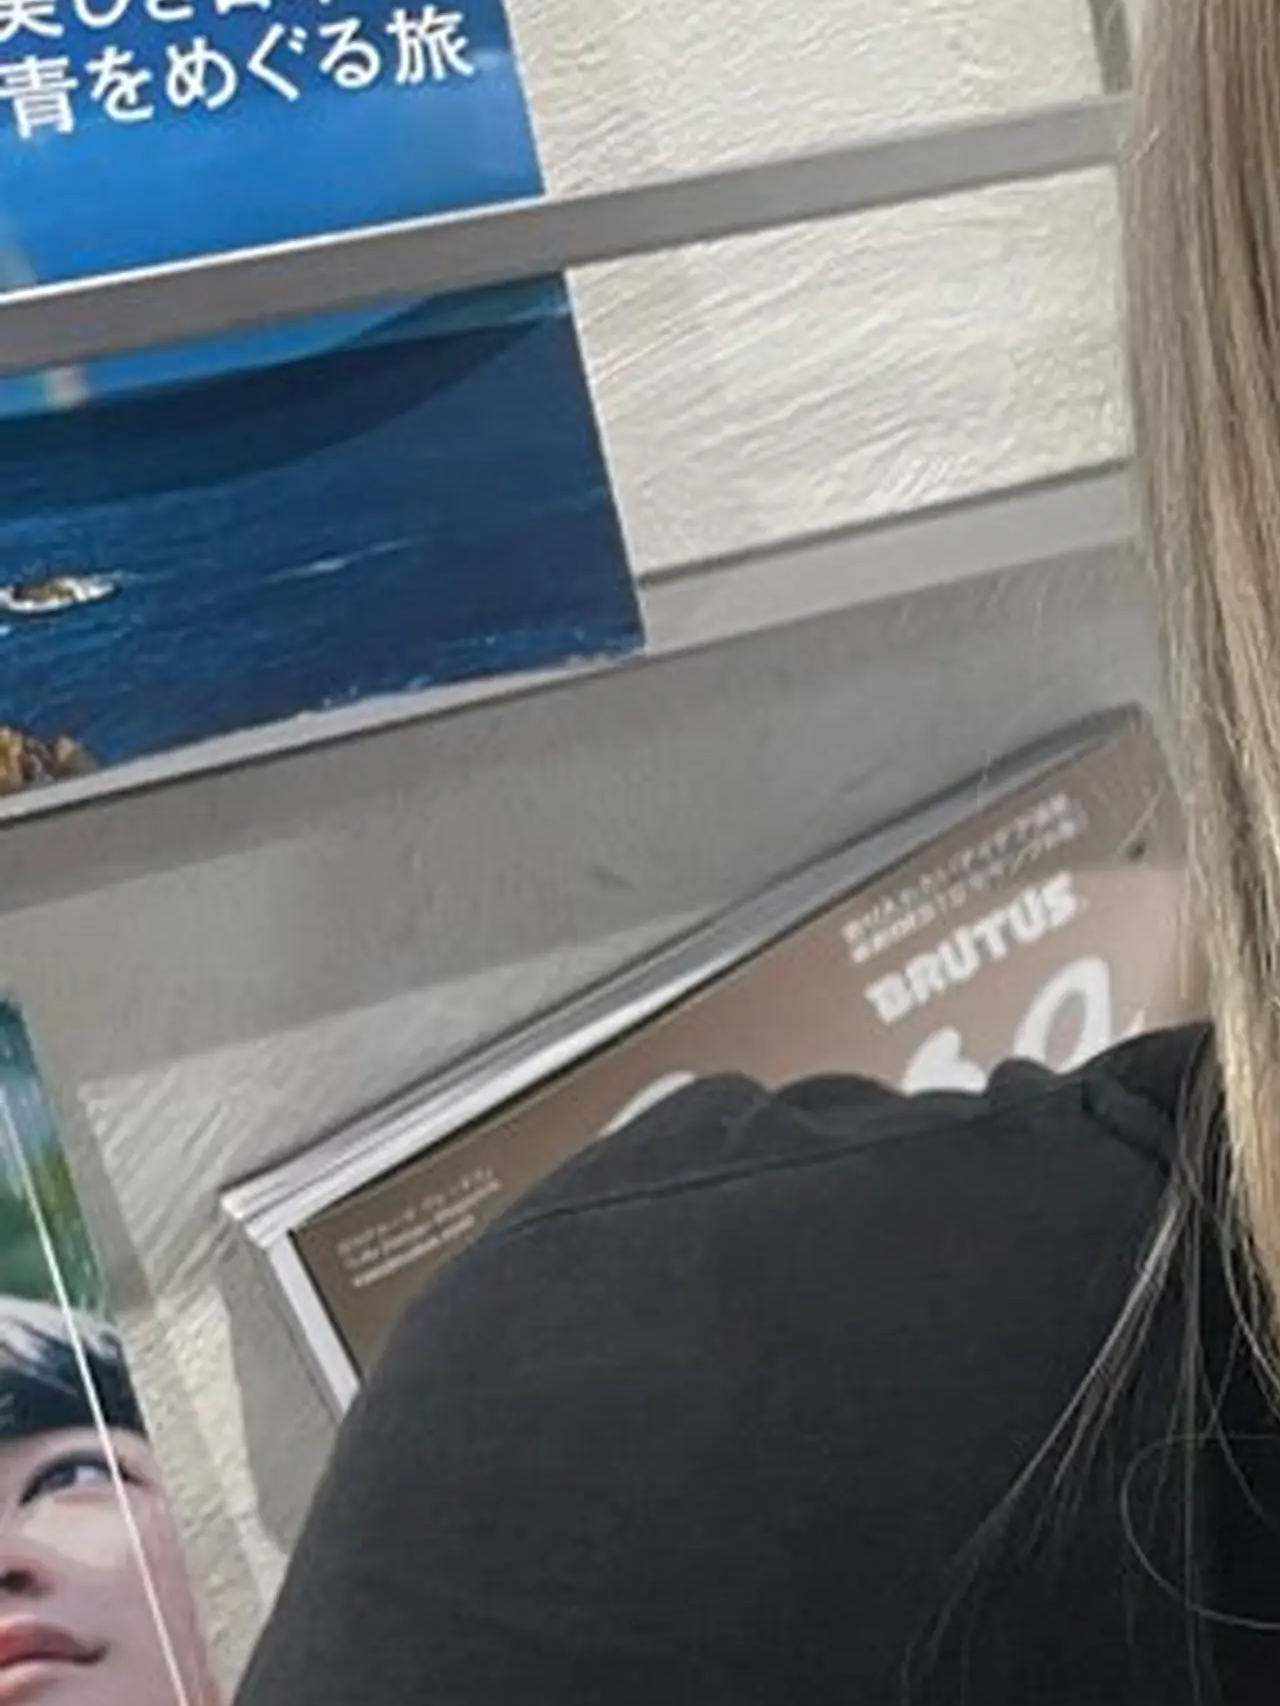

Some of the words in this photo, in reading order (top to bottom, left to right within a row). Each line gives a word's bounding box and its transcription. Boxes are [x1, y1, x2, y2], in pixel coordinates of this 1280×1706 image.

[0, 3, 476, 139] 青をめぐる旅
[864, 870, 1079, 1023] BRUTUS
